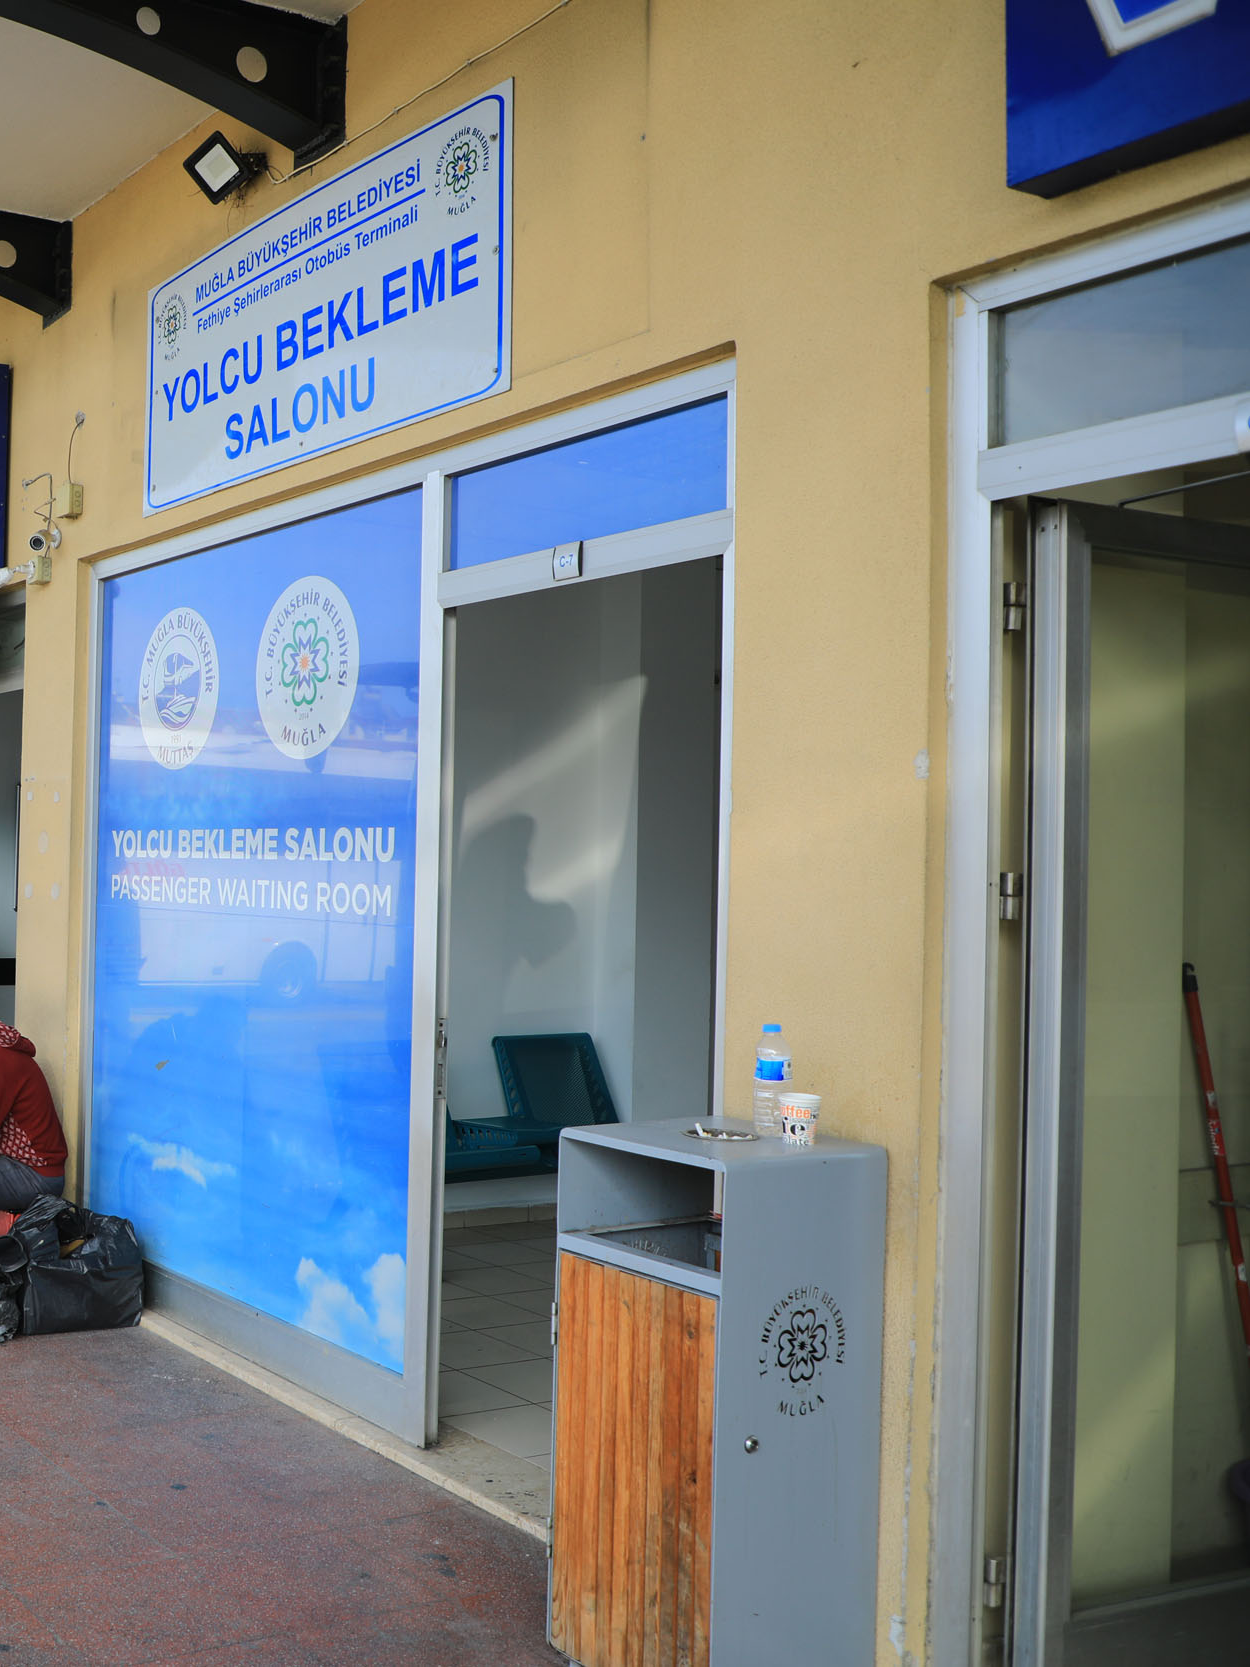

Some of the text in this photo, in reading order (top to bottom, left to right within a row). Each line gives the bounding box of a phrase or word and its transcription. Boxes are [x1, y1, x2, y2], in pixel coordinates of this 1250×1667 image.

[471, 127, 490, 172] BELEDİYESİ
[446, 195, 477, 216] MUĞLA
[195, 158, 421, 304] MUĞLA BÜYÜKŞEHİR BELEDİYESİ
[197, 204, 419, 334] Fethiye Şehirlerarası Otobüs Terminali
[162, 232, 479, 422] YOLCU BEKLEME
[225, 356, 375, 460] SALONU
[559, 553, 574, 568] C-7
[141, 612, 216, 705] T.C. MUĞLA BÜYÜKŞEHİR
[265, 588, 349, 699] T.C. BÜYÜKŞEHİR BELEDİYESİ
[157, 740, 194, 765] MUTTAŞ
[280, 722, 327, 747] MUĞLA
[111, 826, 396, 863] YOLCU BEKLEME SALONU
[111, 873, 392, 917] PASSENGER WAITING ROOM
[760, 1285, 819, 1344] BÜYÜKŞEHİR
[821, 1292, 847, 1364] BELEDİYESİ
[776, 1394, 826, 1417] MUĞLA
